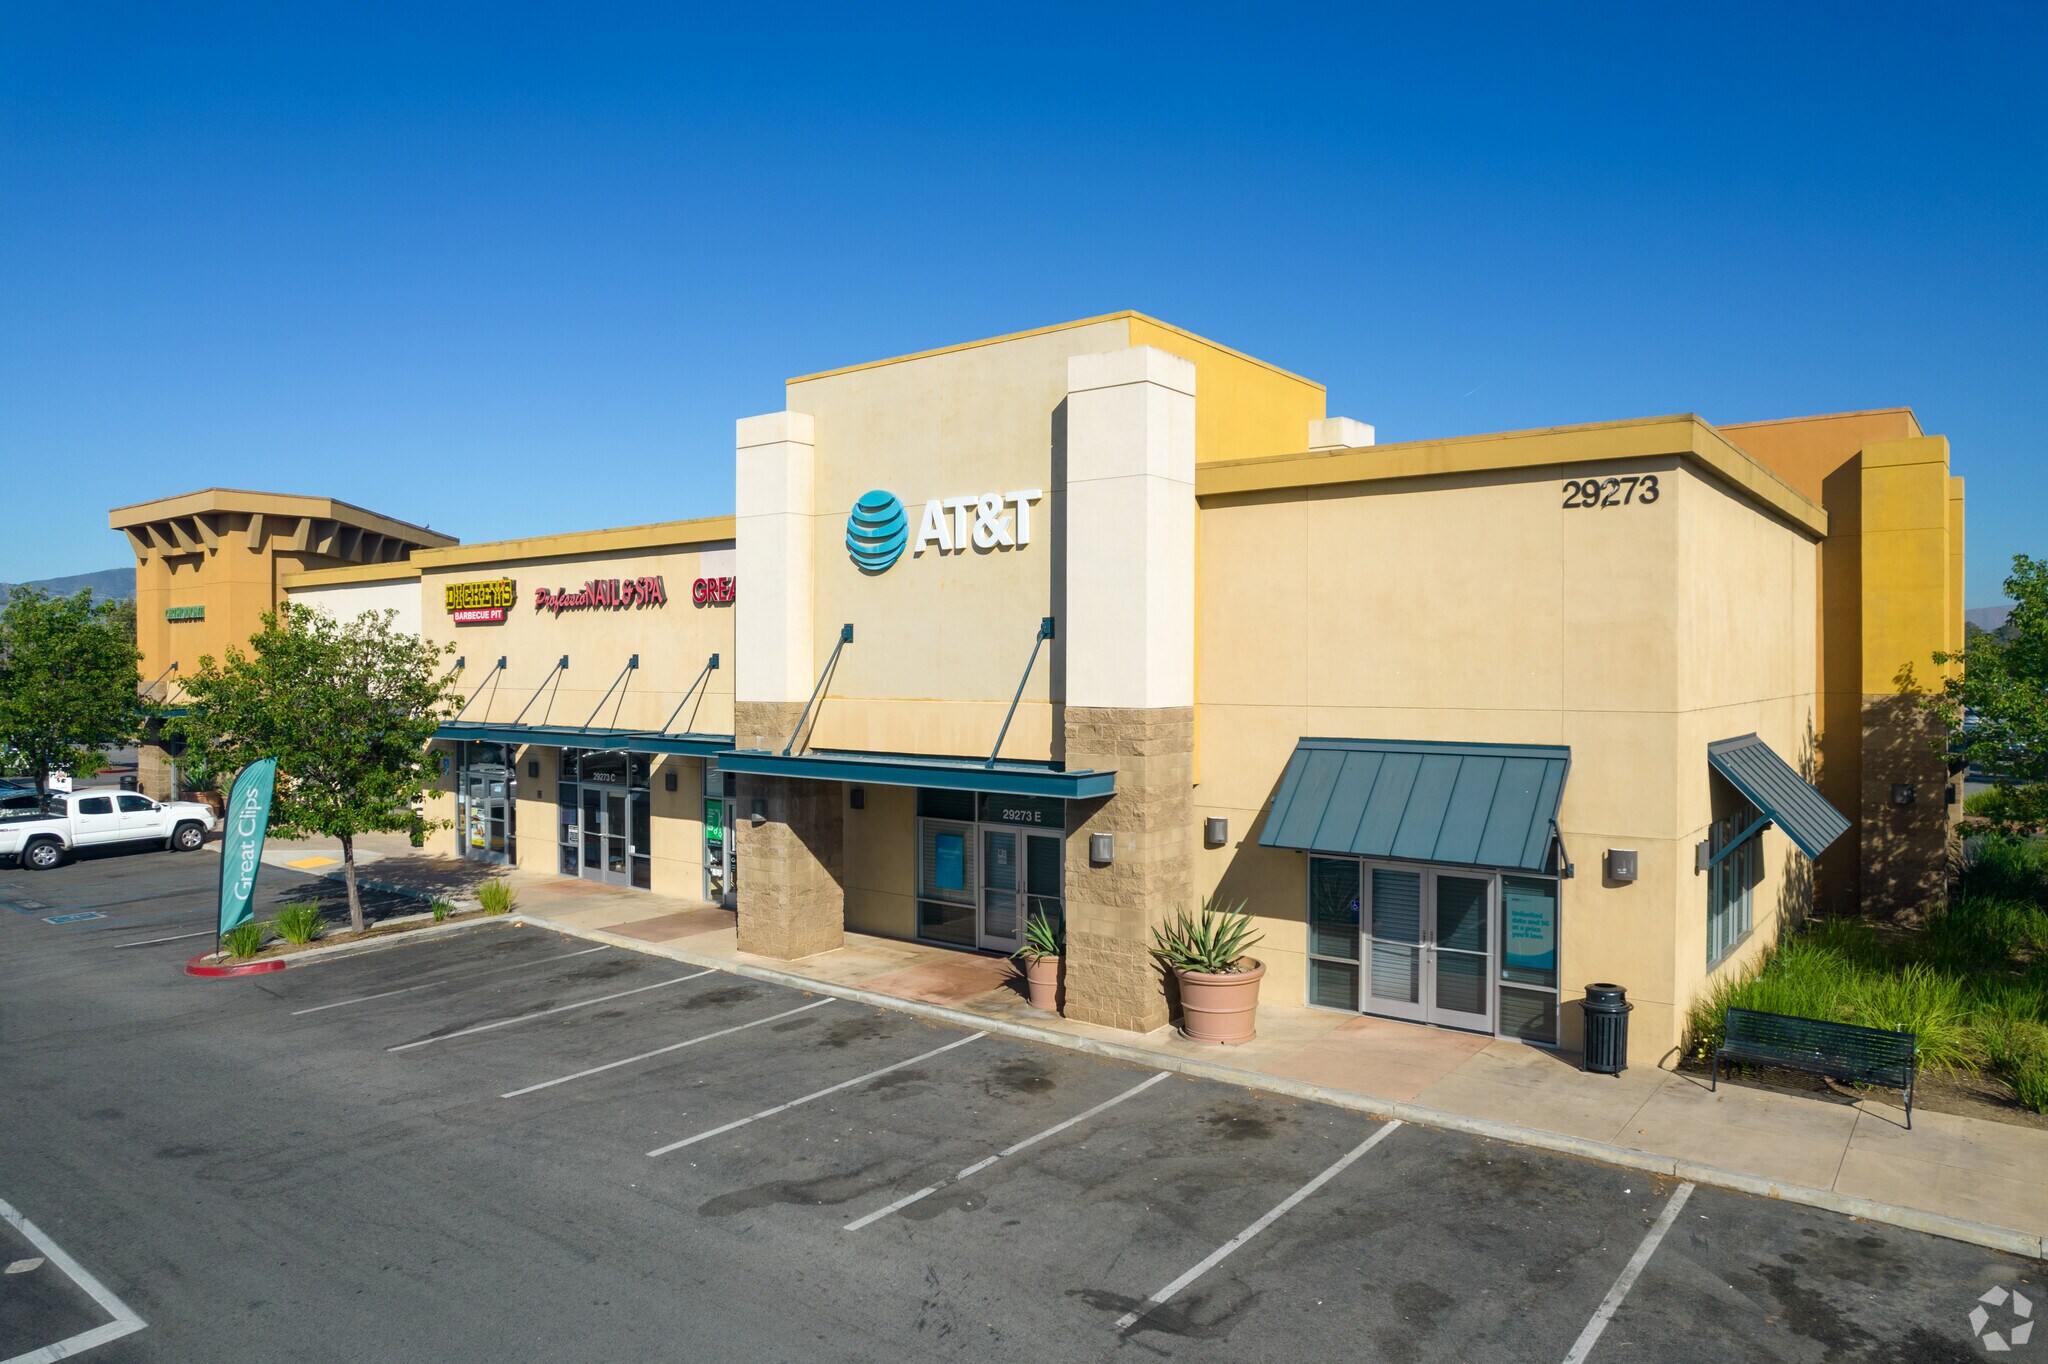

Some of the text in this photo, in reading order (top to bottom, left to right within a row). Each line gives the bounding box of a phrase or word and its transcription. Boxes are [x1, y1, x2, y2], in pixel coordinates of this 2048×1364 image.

[1562, 475, 1659, 509] 29273
[914, 489, 1043, 553] AT&T
[635, 576, 665, 604] SPA
[454, 609, 503, 621] BARBECUE PIT
[1003, 809, 1041, 822] 29273 E
[234, 788, 262, 901] Great Clips
